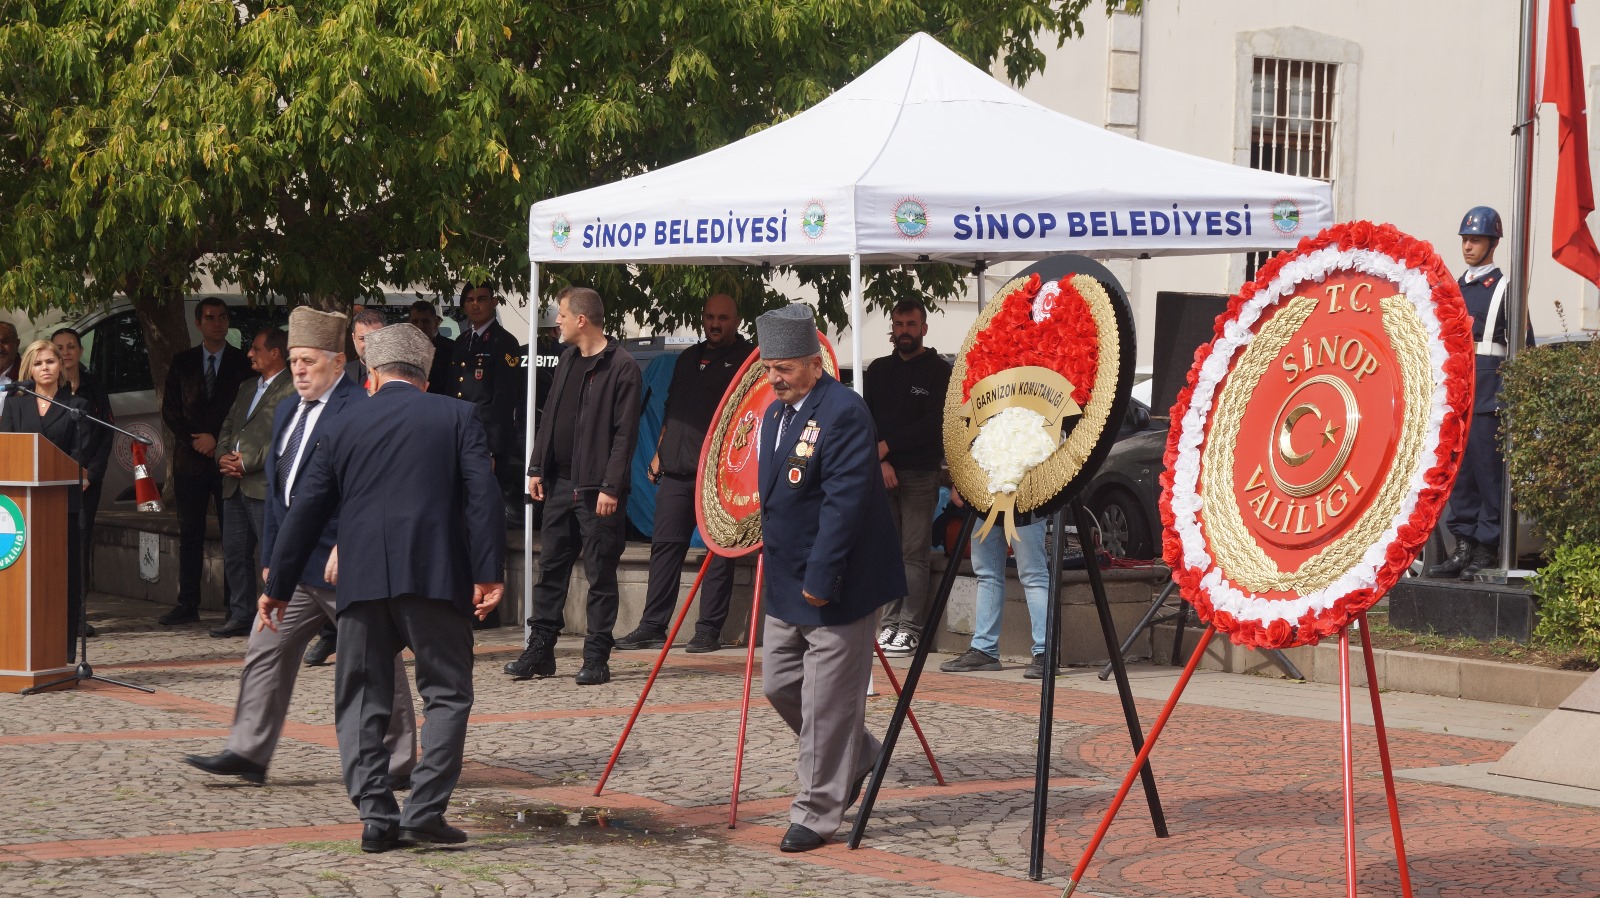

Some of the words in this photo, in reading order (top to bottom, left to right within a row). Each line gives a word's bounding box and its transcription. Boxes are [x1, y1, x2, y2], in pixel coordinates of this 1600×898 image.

[582, 217, 646, 248] SİNOP
[654, 209, 787, 245] BELEDİYESİ
[953, 206, 1057, 241] SİNOP
[1067, 203, 1253, 237] BELEDİYESİ
[520, 354, 560, 368] ZBITA
[1282, 334, 1379, 383] SİNOP
[976, 383, 1017, 410] GARNİZON
[1018, 381, 1065, 409] KOMUTANLIĞI
[1244, 463, 1363, 535] VALİLİĞİ
